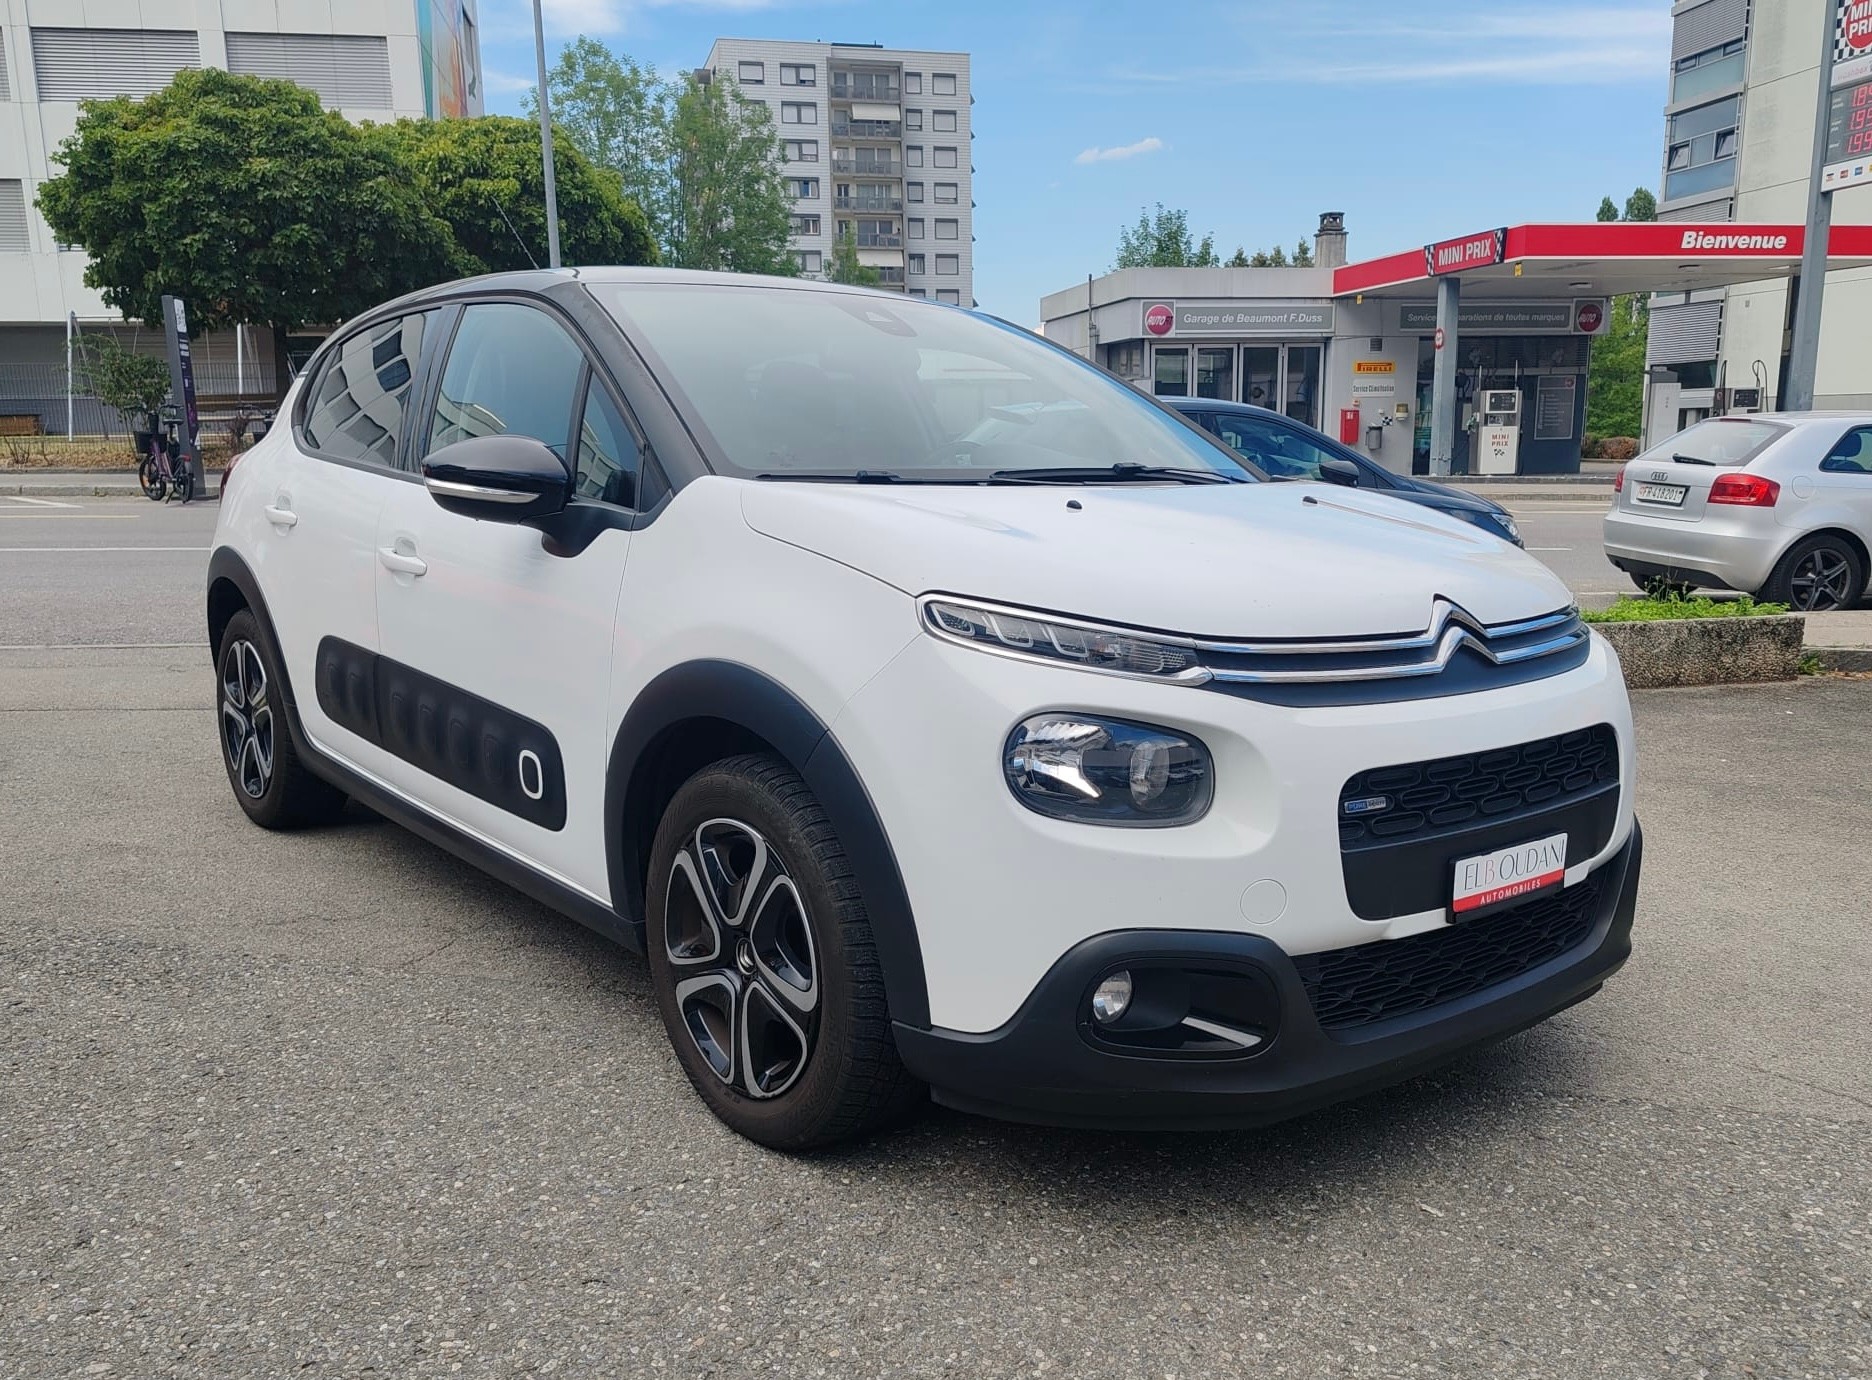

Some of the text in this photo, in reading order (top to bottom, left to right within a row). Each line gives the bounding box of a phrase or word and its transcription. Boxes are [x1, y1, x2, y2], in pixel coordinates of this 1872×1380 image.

[1681, 231, 1787, 249] Bienvenue
[1438, 238, 1492, 267] MINI PRIX
[1183, 313, 1323, 325] Garage de Beaumont F.Duss
[1493, 313, 1504, 322] de
[1505, 313, 1530, 322] toutes
[1531, 314, 1565, 323] marques
[1356, 362, 1393, 372] PIRELLI
[1480, 879, 1541, 905] AUTOMOBILES
